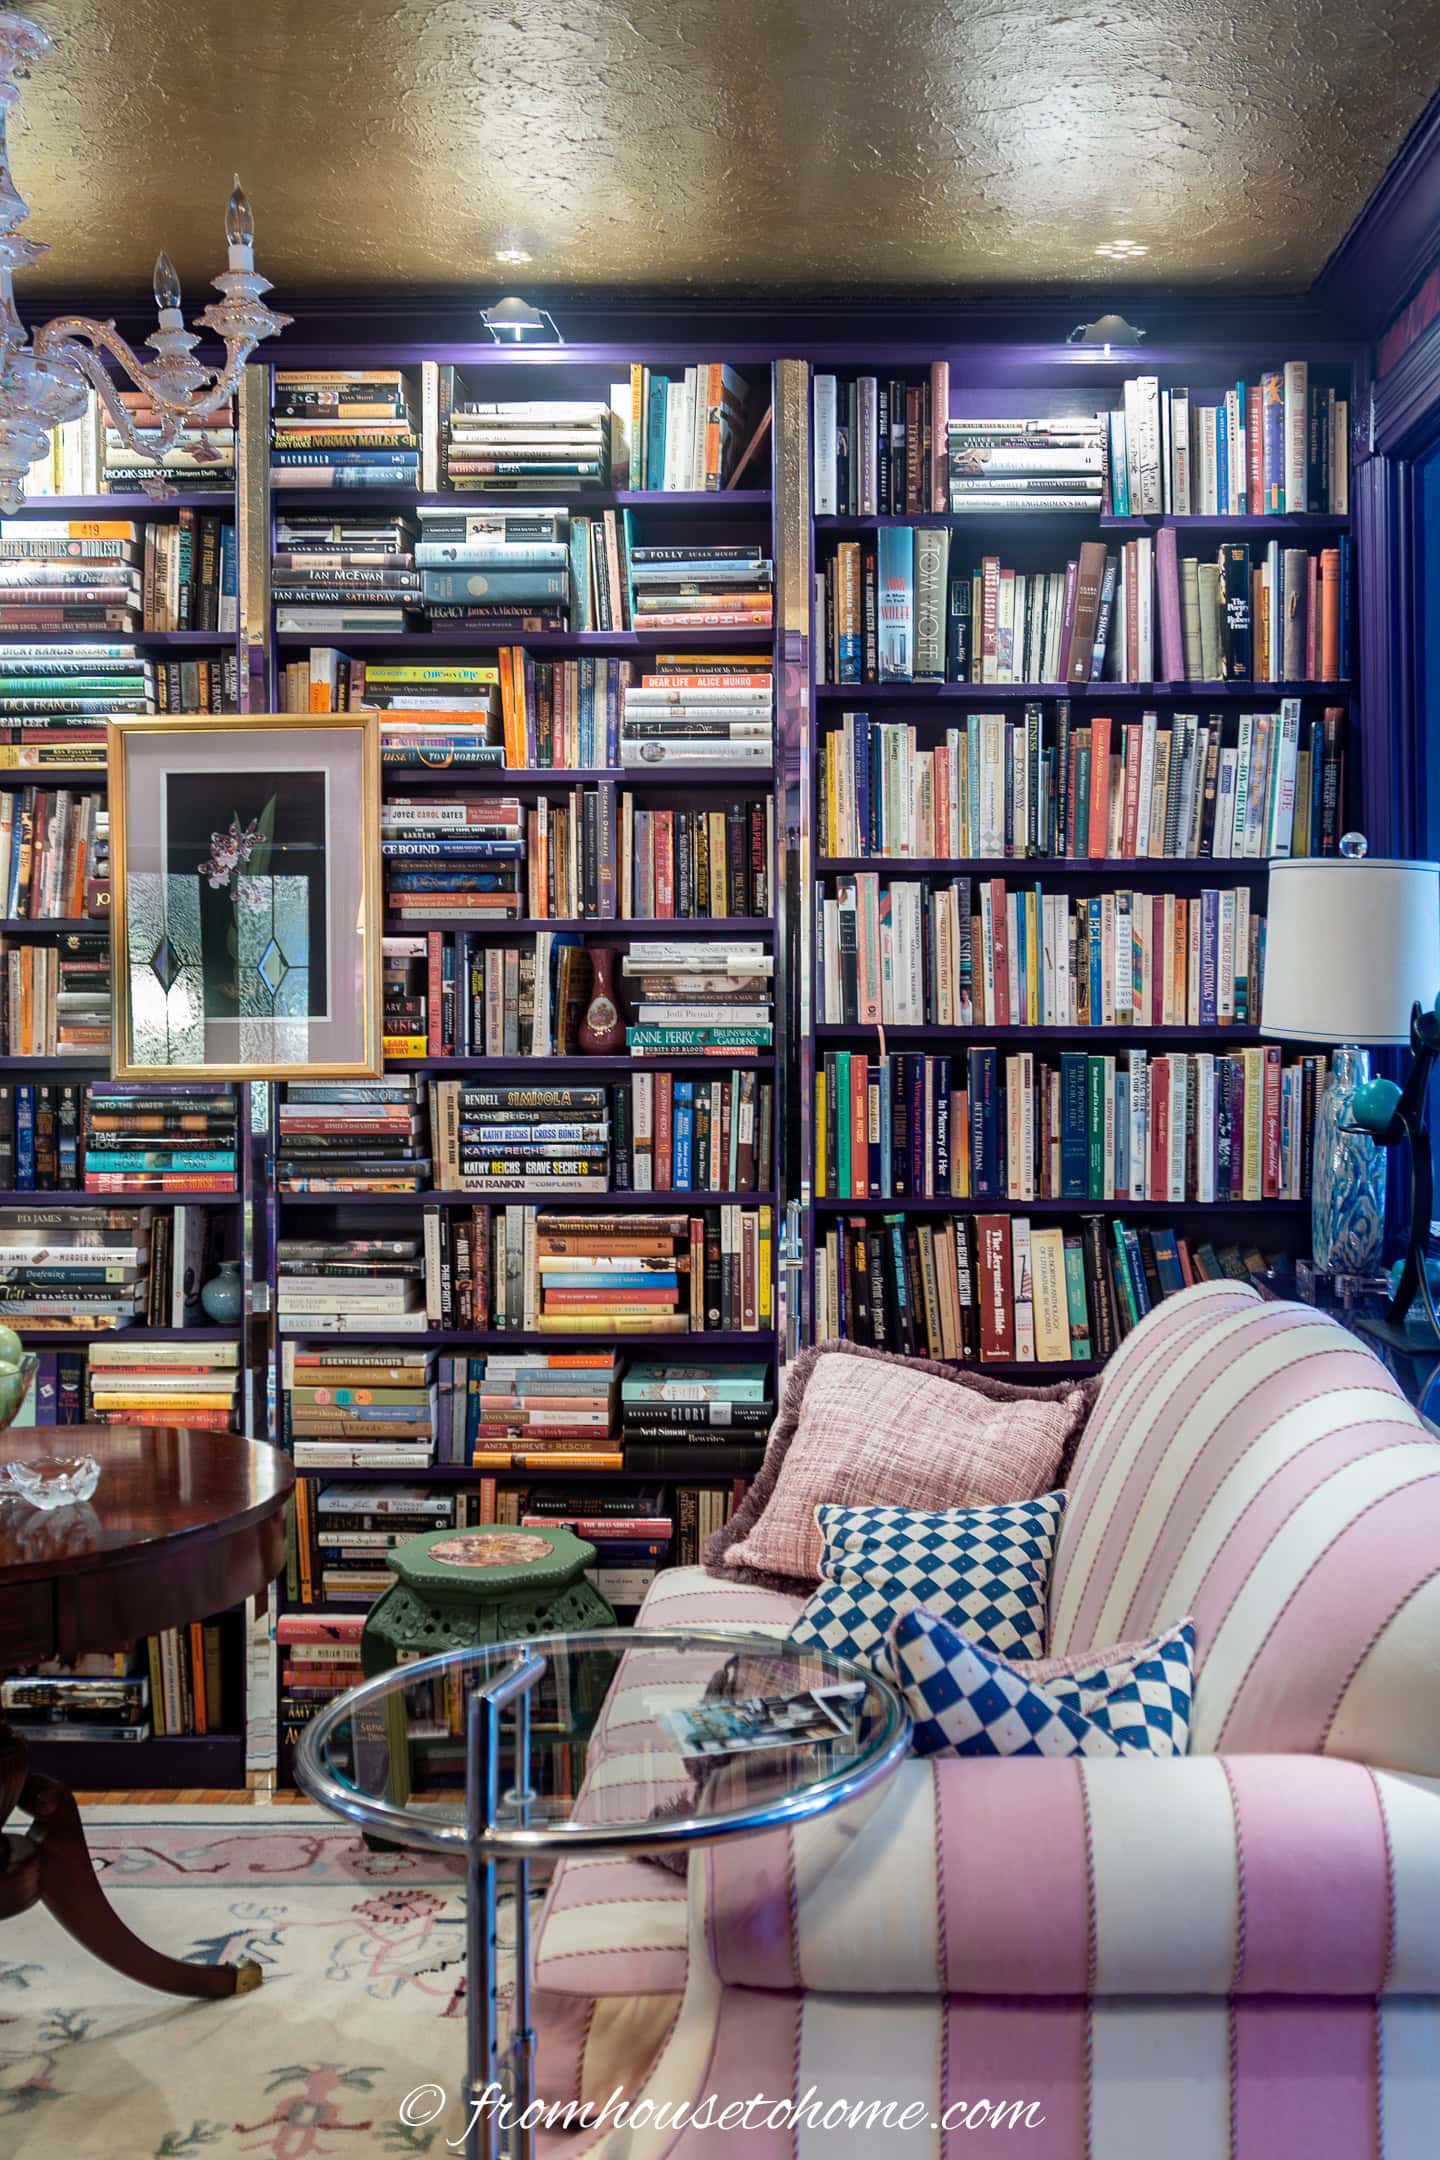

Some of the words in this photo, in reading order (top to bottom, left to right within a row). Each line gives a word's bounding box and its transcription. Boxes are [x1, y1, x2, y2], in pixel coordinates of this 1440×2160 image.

[313, 435, 358, 447] NORMAN
[359, 435, 398, 446] MAILER
[310, 571, 330, 580] IAN
[919, 544, 940, 592] TOM
[1105, 567, 1114, 593] YOUNG
[429, 607, 464, 618] LEGACY
[918, 600, 939, 659] WOLFE
[1097, 616, 1107, 643] SHACK
[649, 678, 670, 687] DEAR
[672, 678, 689, 687] LIFE
[697, 678, 721, 687] ALICE
[723, 677, 751, 687] MUNRO
[1282, 779, 1294, 811] LIFE
[1222, 923, 1232, 934] THE
[1203, 963, 1214, 1001] INTIMACY
[633, 1032, 662, 1043] ANNE
[665, 1032, 694, 1043] PERRY
[465, 1095, 499, 1105] RENDELL
[482, 1129, 503, 1139] KATHY
[505, 1129, 528, 1139] REICHS
[534, 1129, 555, 1139] CROSS
[559, 1129, 580, 1139] BONES
[937, 1111, 947, 1145] Memory
[464, 1161, 489, 1174] KATHY
[492, 1161, 520, 1174] REICHS
[525, 1162, 550, 1173] GRAVE
[552, 1161, 589, 1174] SECRETS
[992, 1229, 1003, 1252] The
[958, 1247, 968, 1268] BECAME
[958, 1269, 971, 1306] CHRISTIAN
[993, 1252, 1005, 1307] Jerusalem
[994, 1308, 1005, 1335] Bible
[671, 1408, 705, 1421] GLORY
